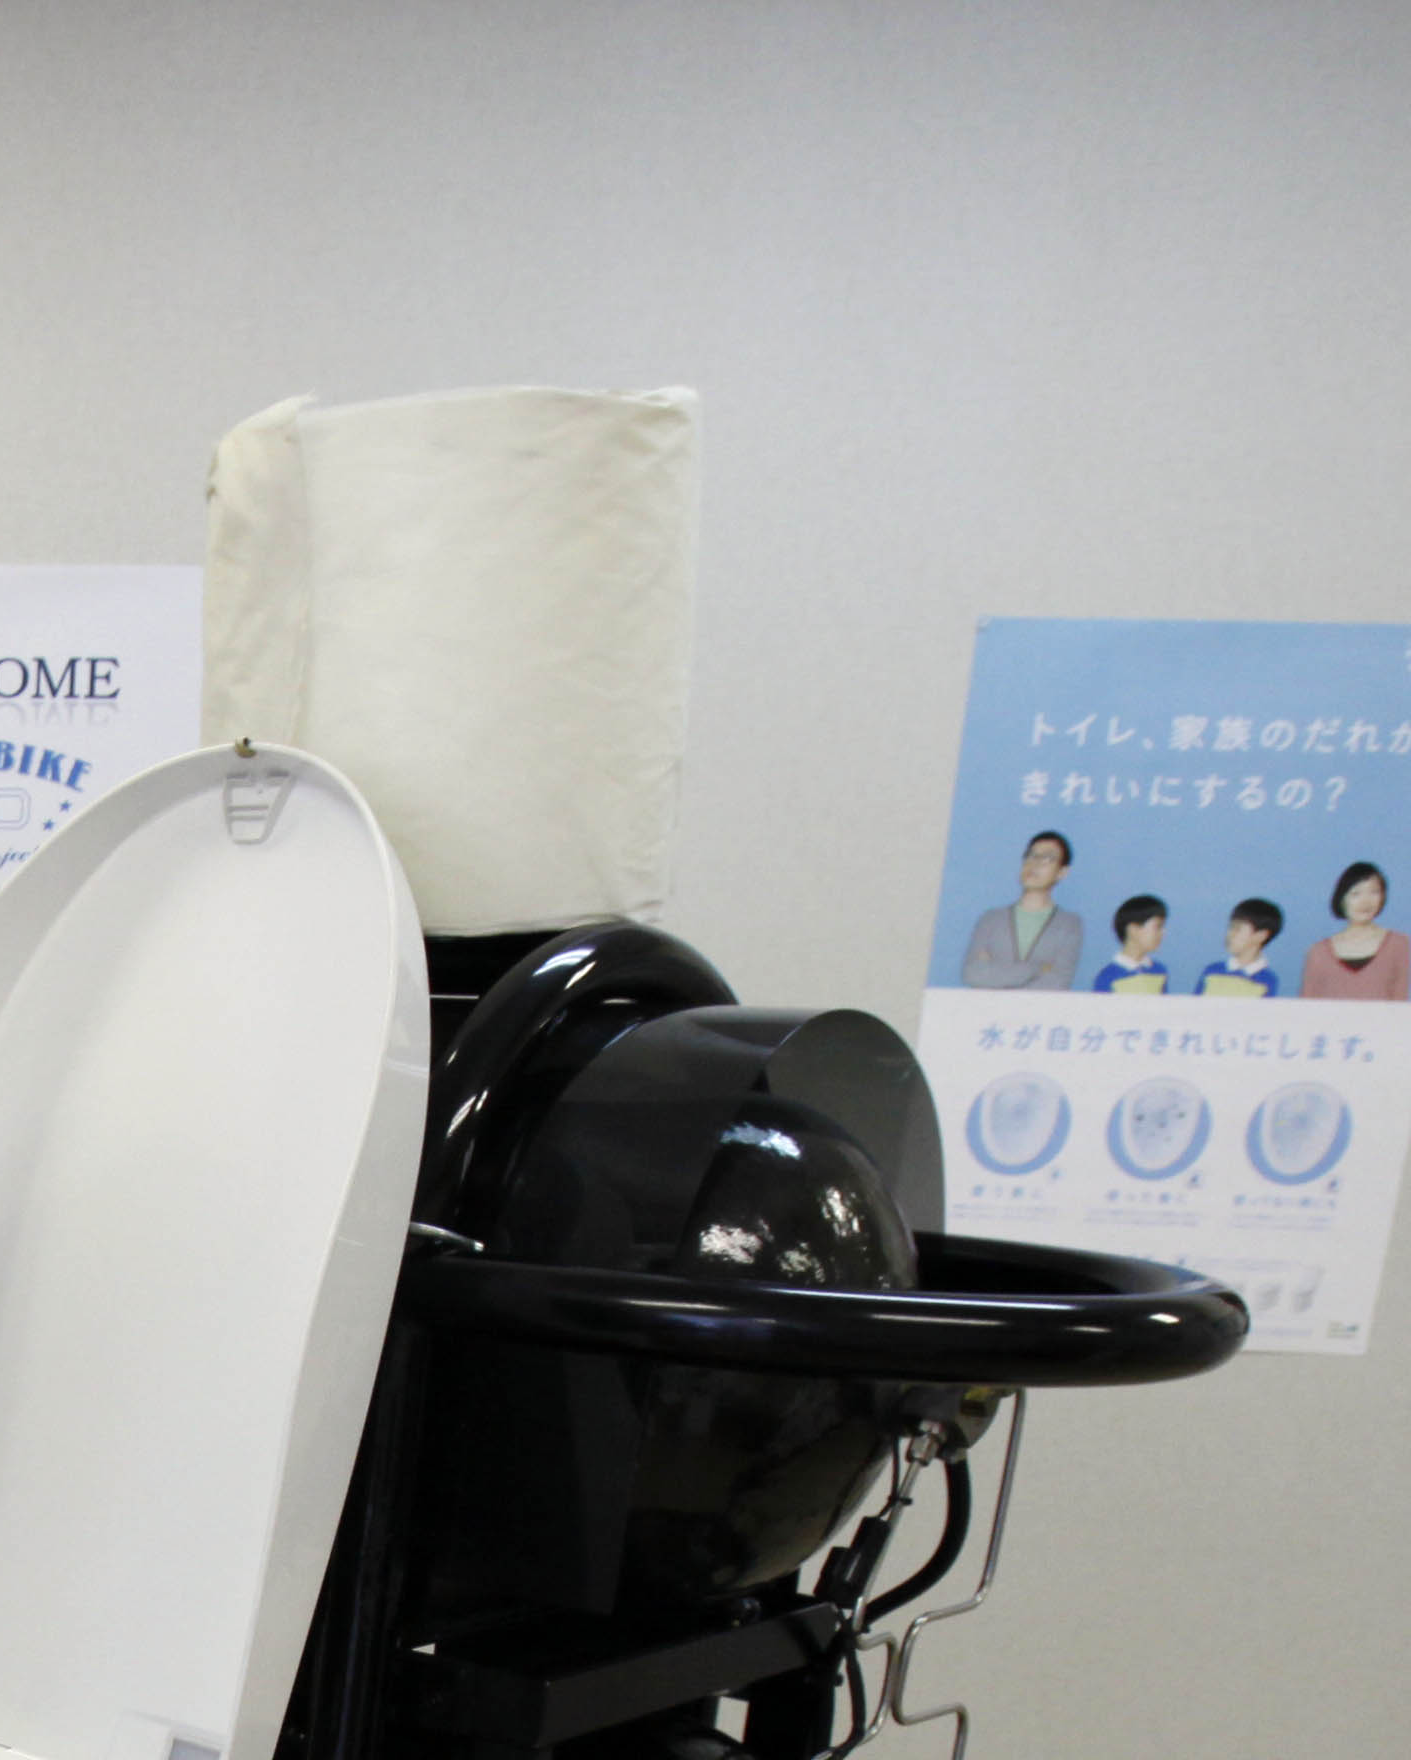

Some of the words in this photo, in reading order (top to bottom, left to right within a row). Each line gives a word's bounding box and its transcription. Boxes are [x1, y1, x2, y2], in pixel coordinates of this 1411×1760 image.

[977, 1023, 1375, 1063] 水が自分できれいにします。
